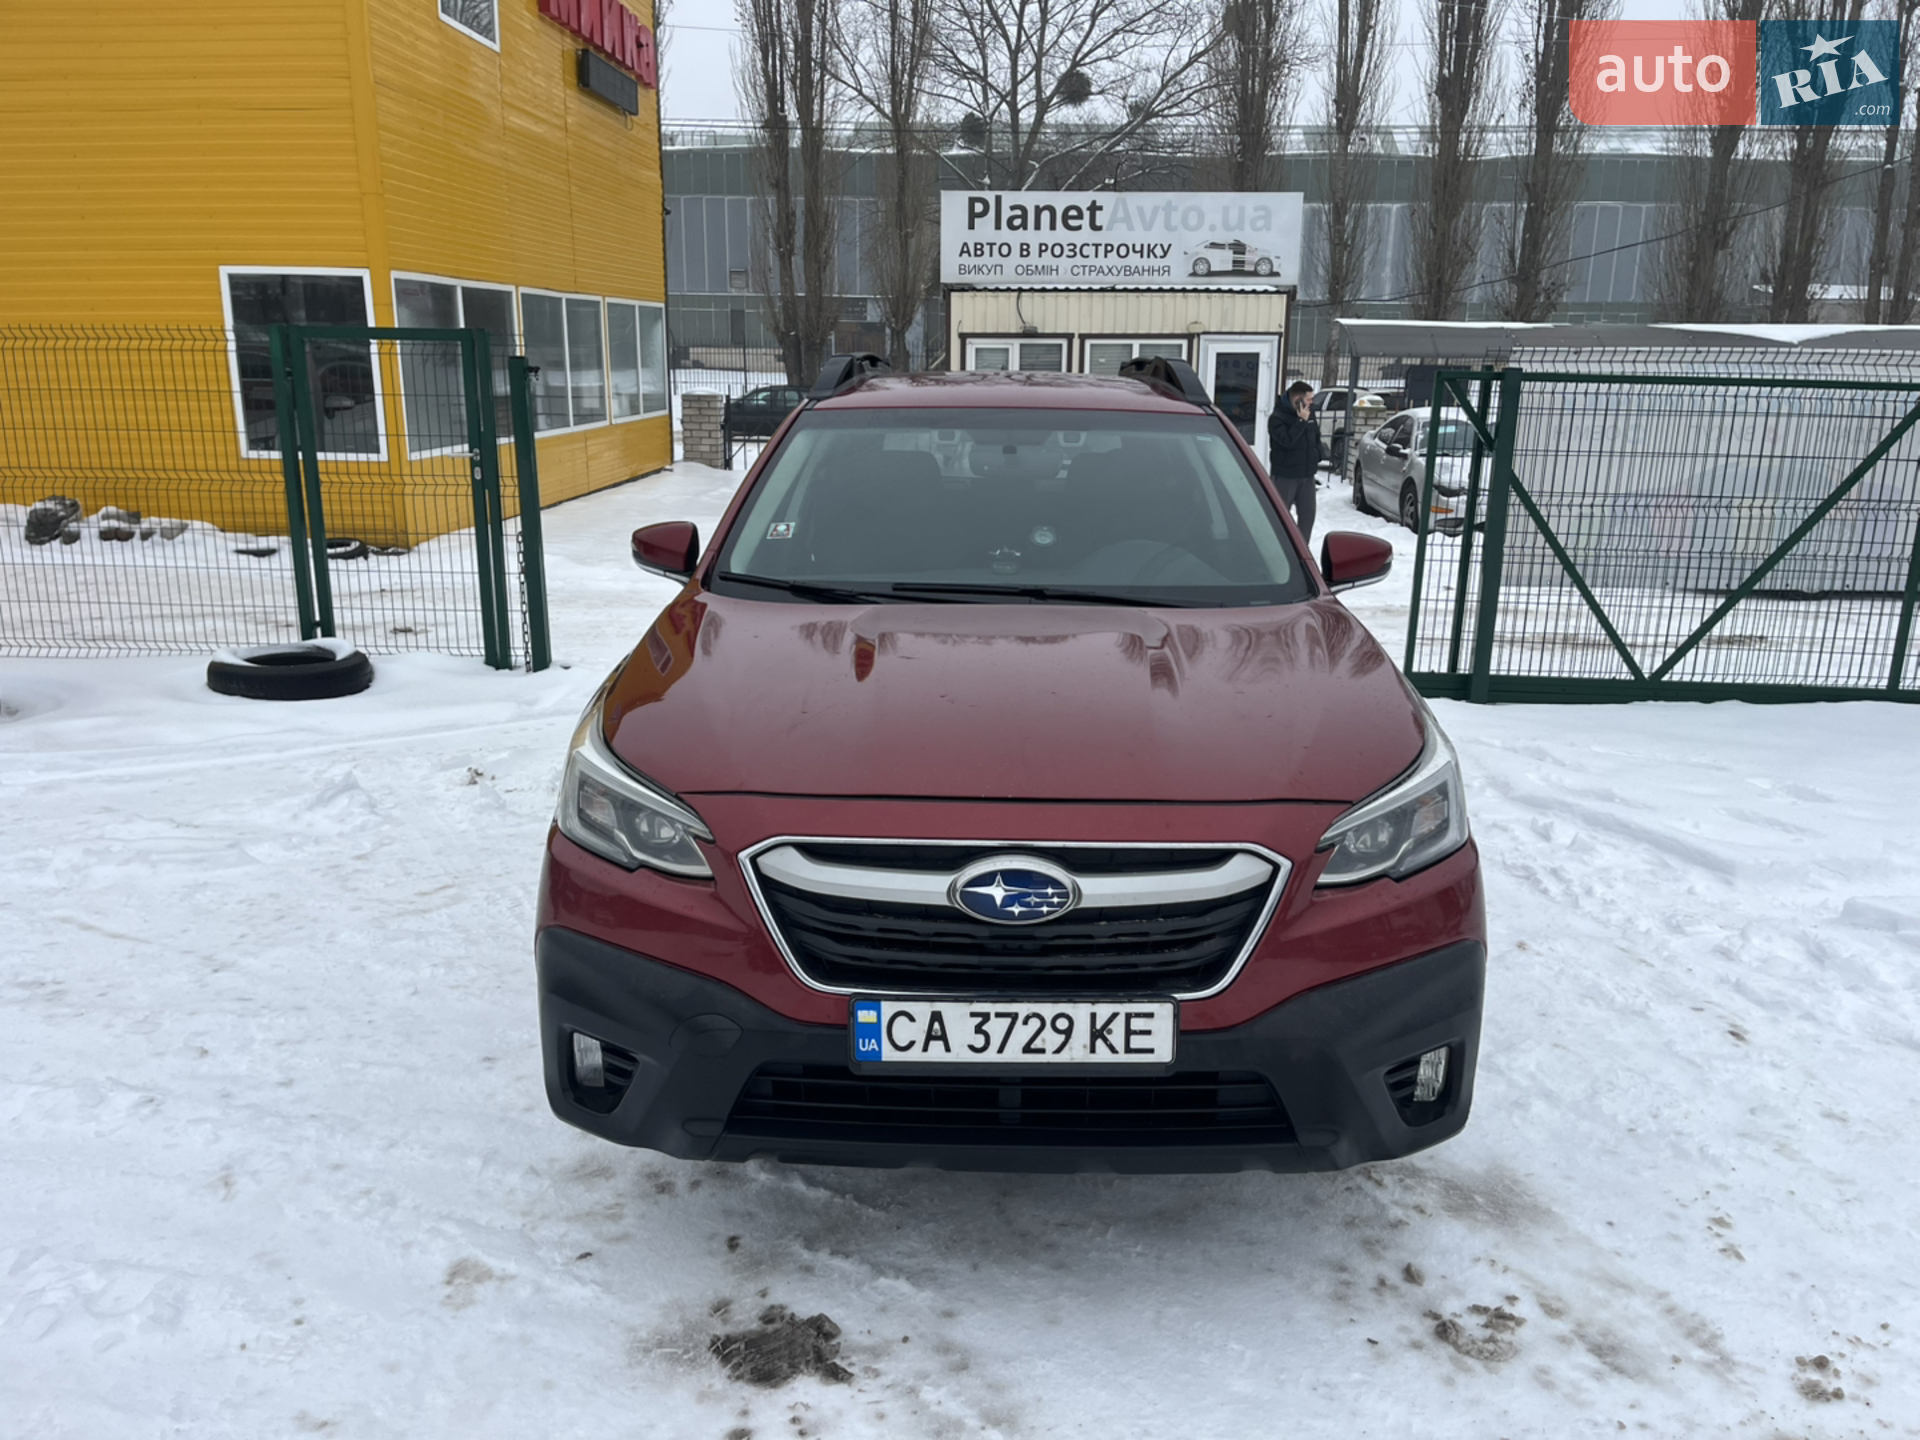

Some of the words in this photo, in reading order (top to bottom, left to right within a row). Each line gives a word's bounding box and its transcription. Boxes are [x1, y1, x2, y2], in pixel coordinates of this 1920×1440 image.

[958, 242, 1012, 258] АВТО
[1019, 243, 1031, 258] В
[1038, 243, 1173, 259] РОЗСТРОЧКУ
[958, 264, 1004, 276] ВИКУП
[1014, 264, 1059, 276] ОБМІН
[1070, 264, 1171, 277] СТРАХУВАННЯ
[886, 1010, 952, 1053] CA
[967, 1012, 1075, 1055] 3729
[1089, 1012, 1155, 1055] KE
[859, 1038, 879, 1051] UA
